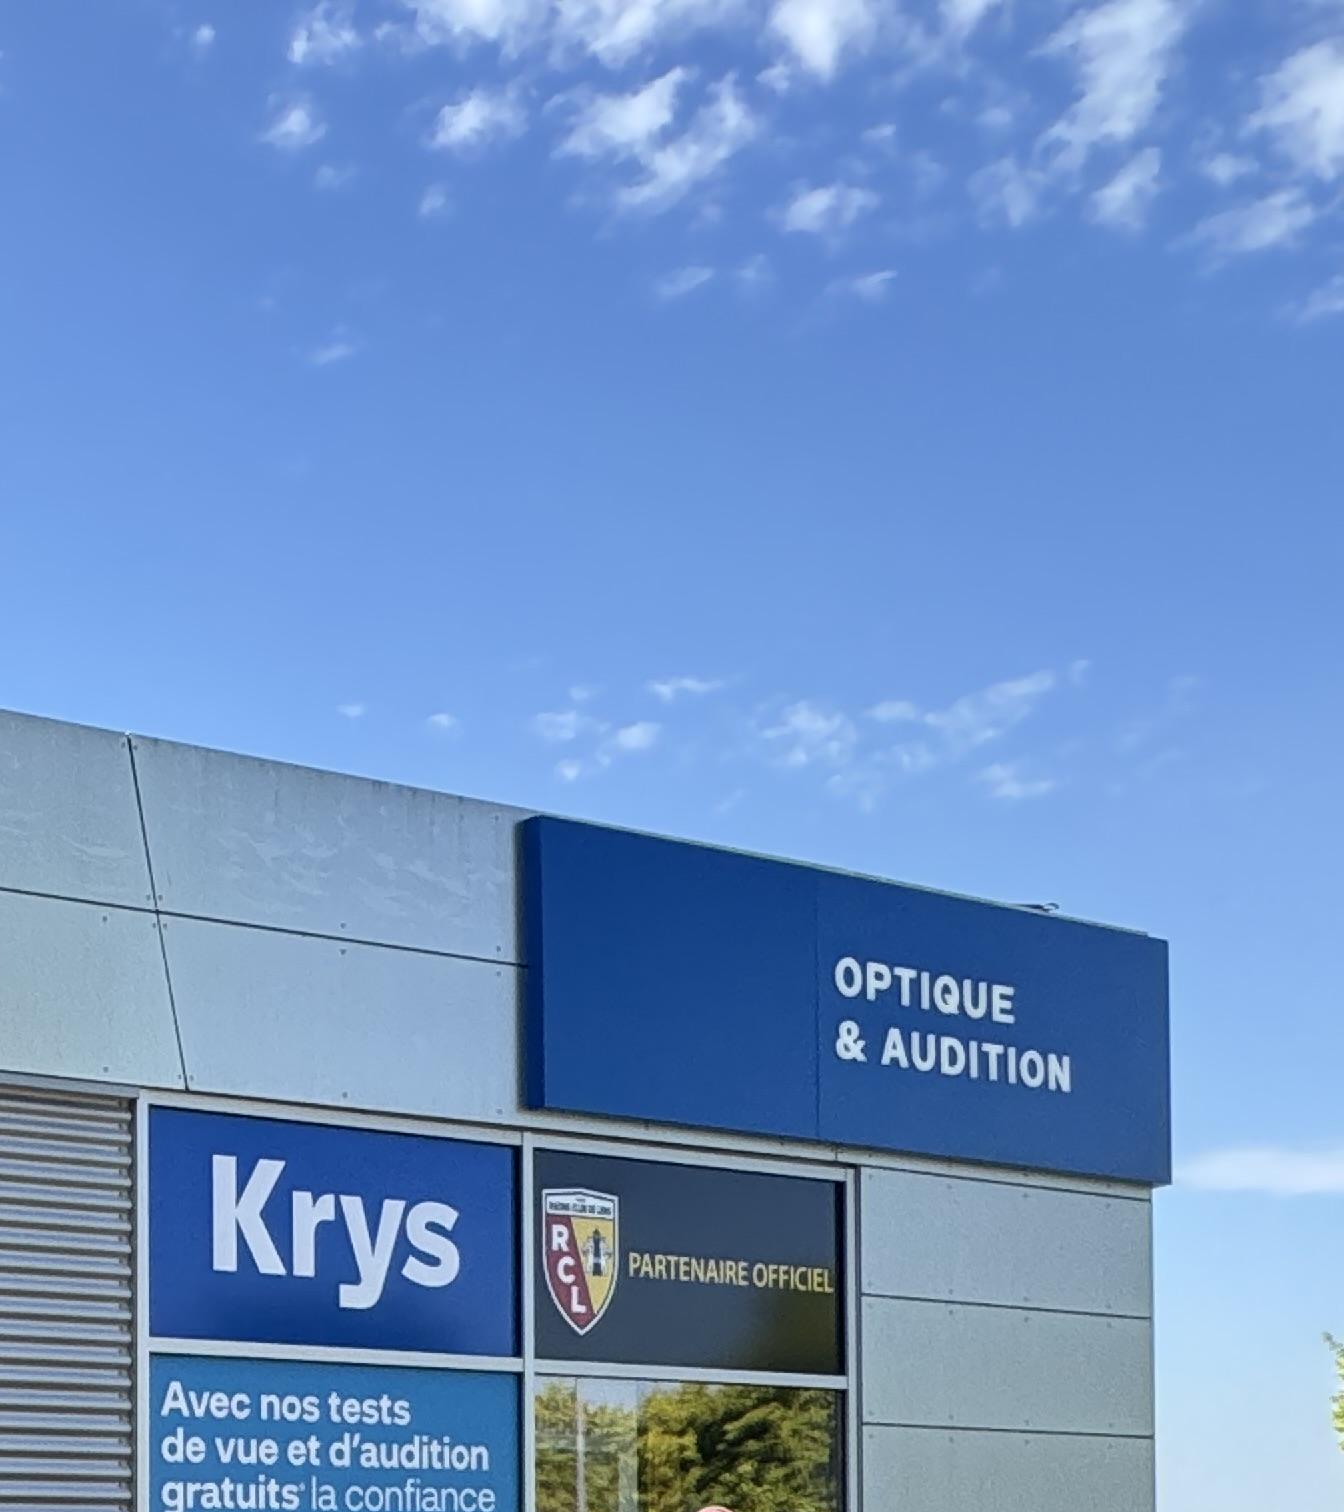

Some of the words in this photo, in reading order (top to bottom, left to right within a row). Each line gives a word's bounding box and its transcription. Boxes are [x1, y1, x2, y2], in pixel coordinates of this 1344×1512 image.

[835, 956, 1015, 1024] OPTIQUE
[836, 1020, 867, 1063] &
[881, 1027, 1071, 1093] AUDITION
[212, 1154, 460, 1310] Krys
[629, 1252, 749, 1286] PARTENAIRE
[752, 1263, 834, 1294] OFFICIEL
[161, 1381, 251, 1419] Avec
[260, 1393, 321, 1423] nos
[329, 1391, 411, 1426] tests
[161, 1427, 206, 1465] de
[215, 1437, 279, 1466] vue
[287, 1435, 321, 1467] et
[329, 1432, 490, 1471] d'audition
[312, 1476, 338, 1512] la
[345, 1478, 496, 1512] confiance
